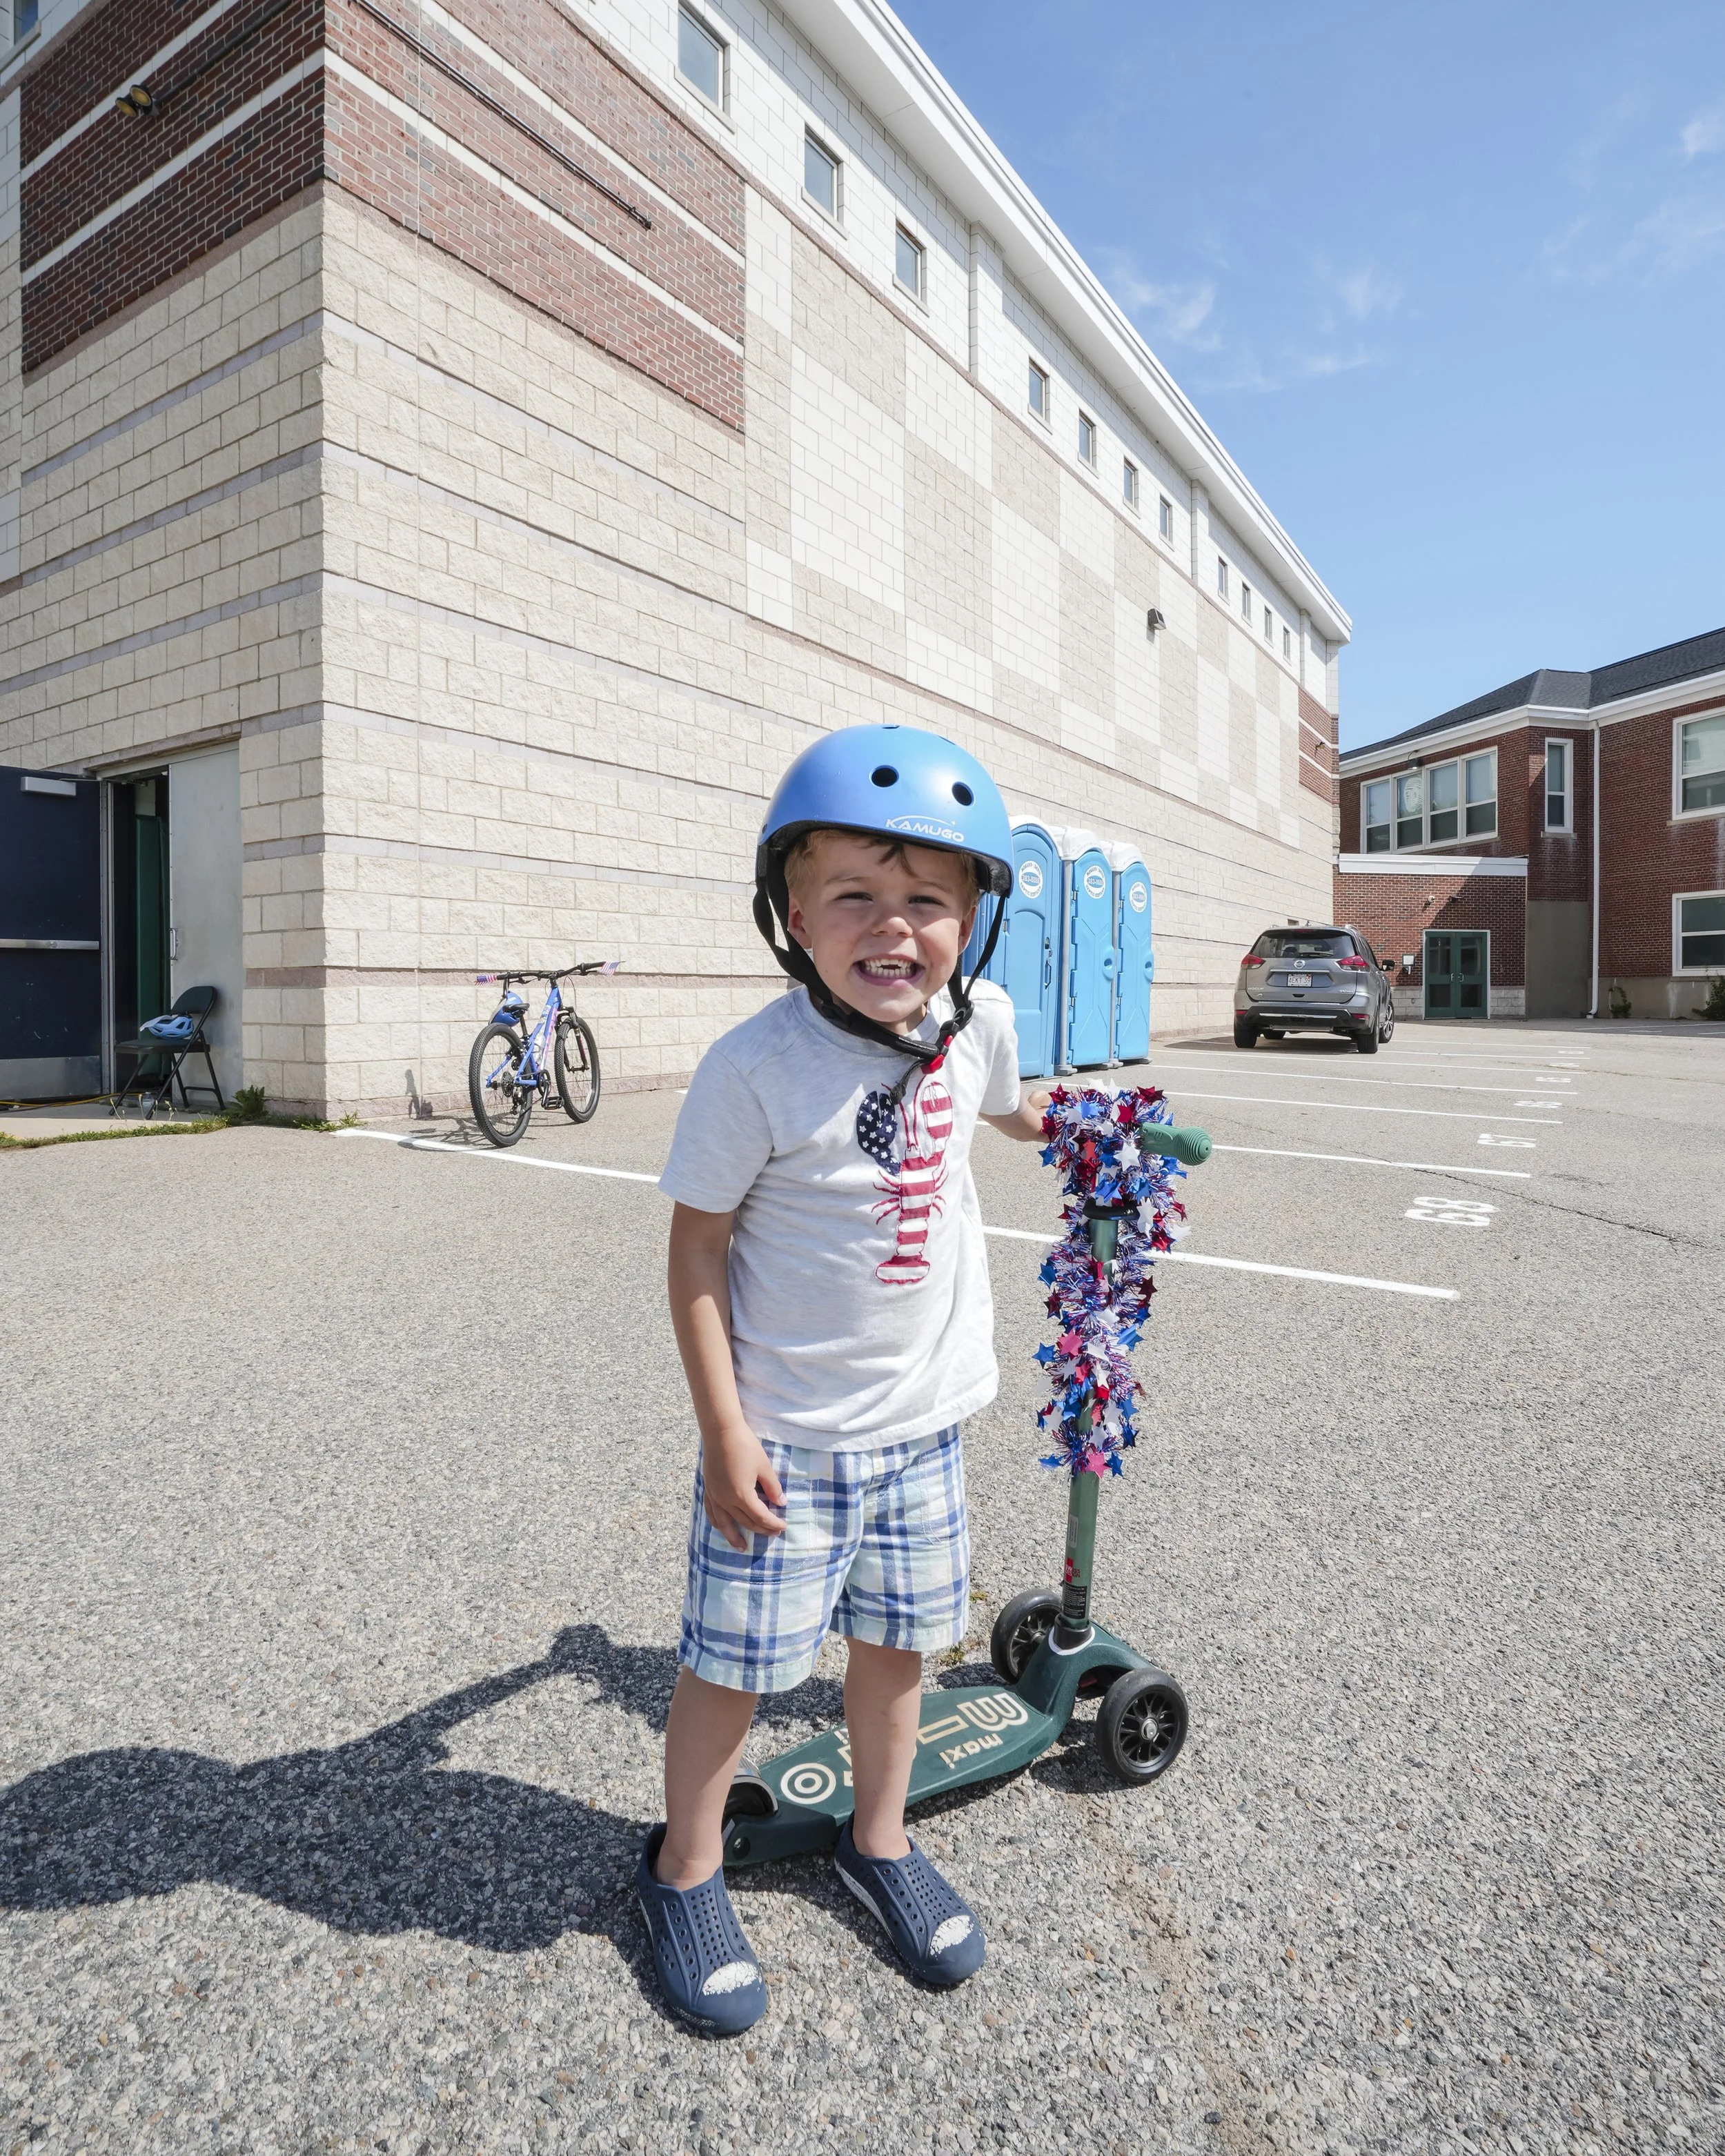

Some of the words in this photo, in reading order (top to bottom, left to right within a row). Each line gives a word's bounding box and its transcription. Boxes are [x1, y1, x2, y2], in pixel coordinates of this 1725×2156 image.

[885, 818, 965, 842] KAMUGO
[1404, 1196, 1500, 1227] 68
[938, 1732, 1004, 1770] maxi
